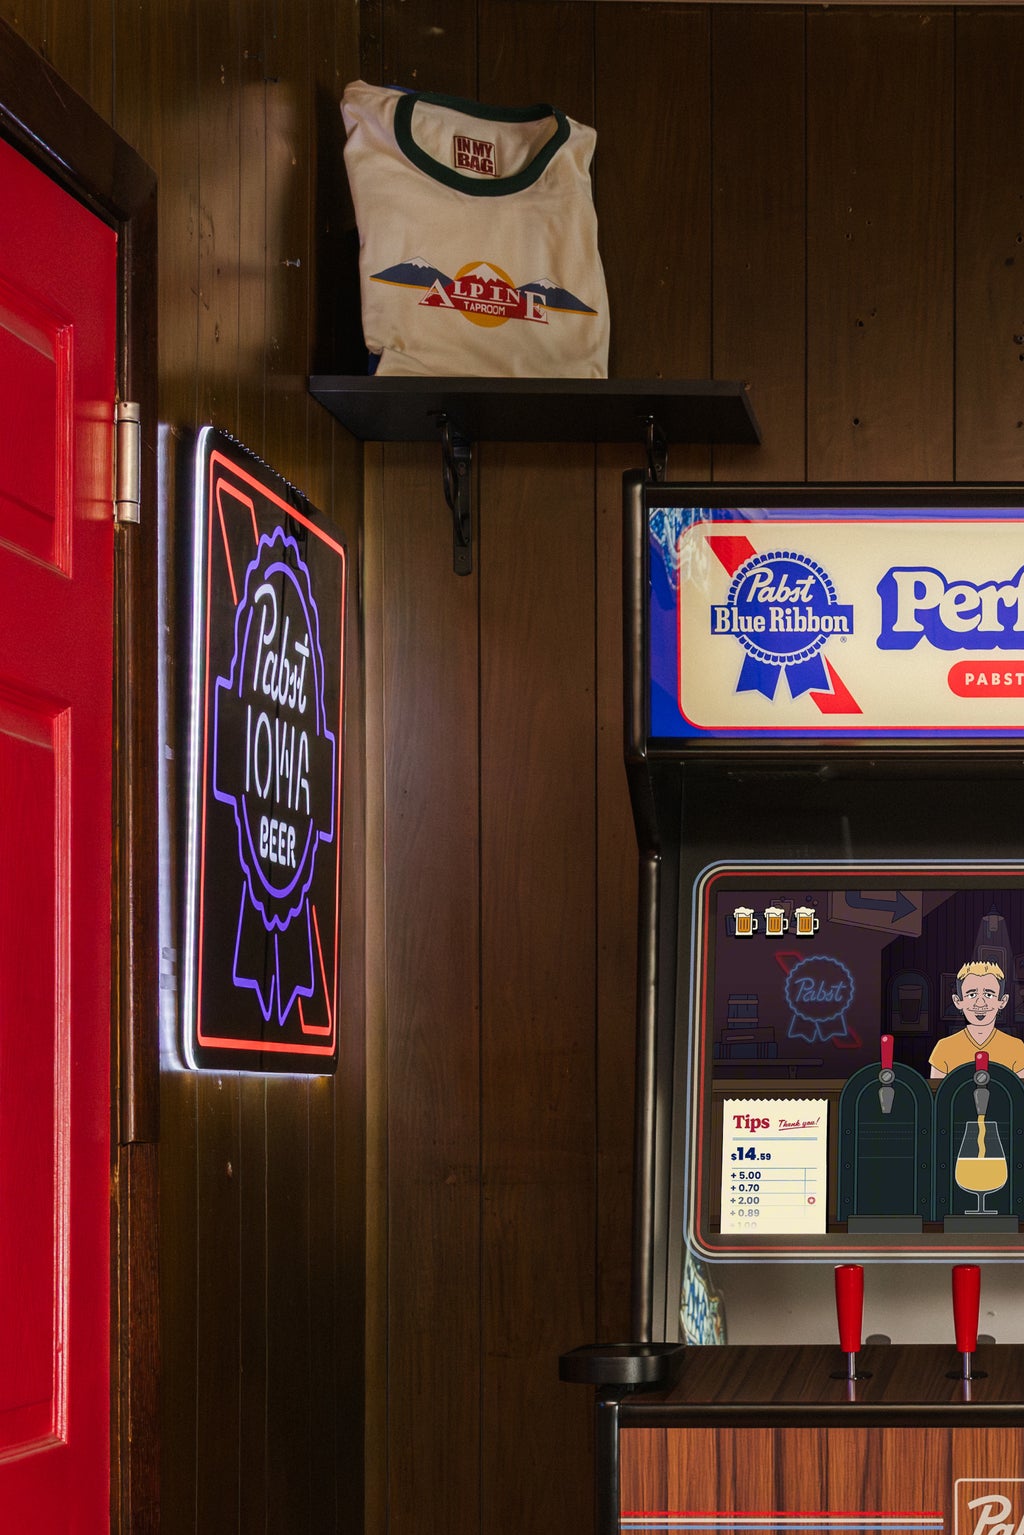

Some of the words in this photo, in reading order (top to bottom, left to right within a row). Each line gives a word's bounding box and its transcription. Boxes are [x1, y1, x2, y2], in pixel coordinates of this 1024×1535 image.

[457, 138, 471, 153] IN
[473, 141, 492, 158] MY
[457, 152, 494, 174] BAG
[419, 278, 548, 322] ALPINE
[463, 301, 506, 316] TAPROOM
[745, 566, 816, 603] Pabst
[714, 606, 767, 633] Blue
[769, 606, 850, 633] Ribbon
[253, 583, 310, 714] Pabst
[244, 704, 311, 816] IOWA
[259, 815, 297, 869] BEER
[794, 977, 847, 1002] Pabst
[732, 1113, 771, 1133] Tips
[778, 1119, 801, 1128] Thank
[801, 1116, 821, 1129] you!
[730, 1146, 772, 1161] $14.59
